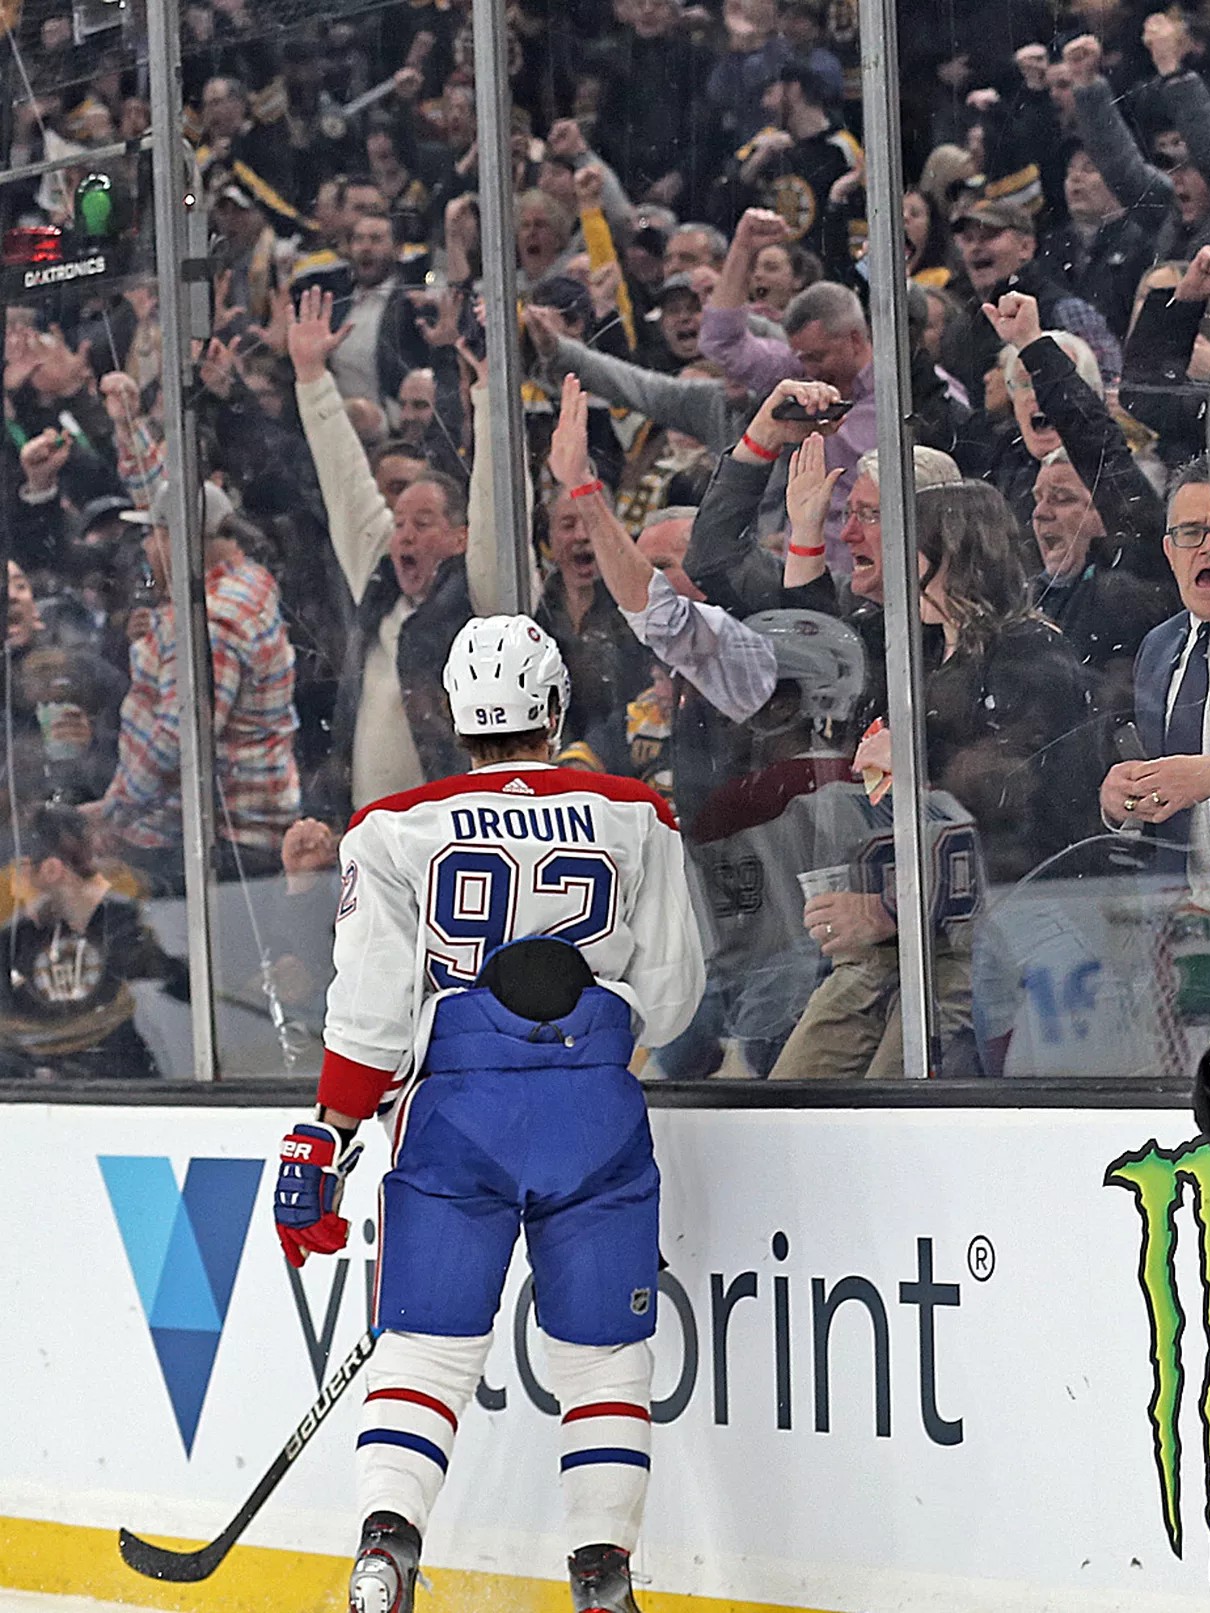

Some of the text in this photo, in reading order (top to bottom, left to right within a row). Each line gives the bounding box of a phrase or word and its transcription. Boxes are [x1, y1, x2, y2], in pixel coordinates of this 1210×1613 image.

[475, 707, 507, 727] 92
[451, 804, 597, 844] DROUIN
[426, 842, 618, 993] 92
[285, 1345, 363, 1460] BAUER
